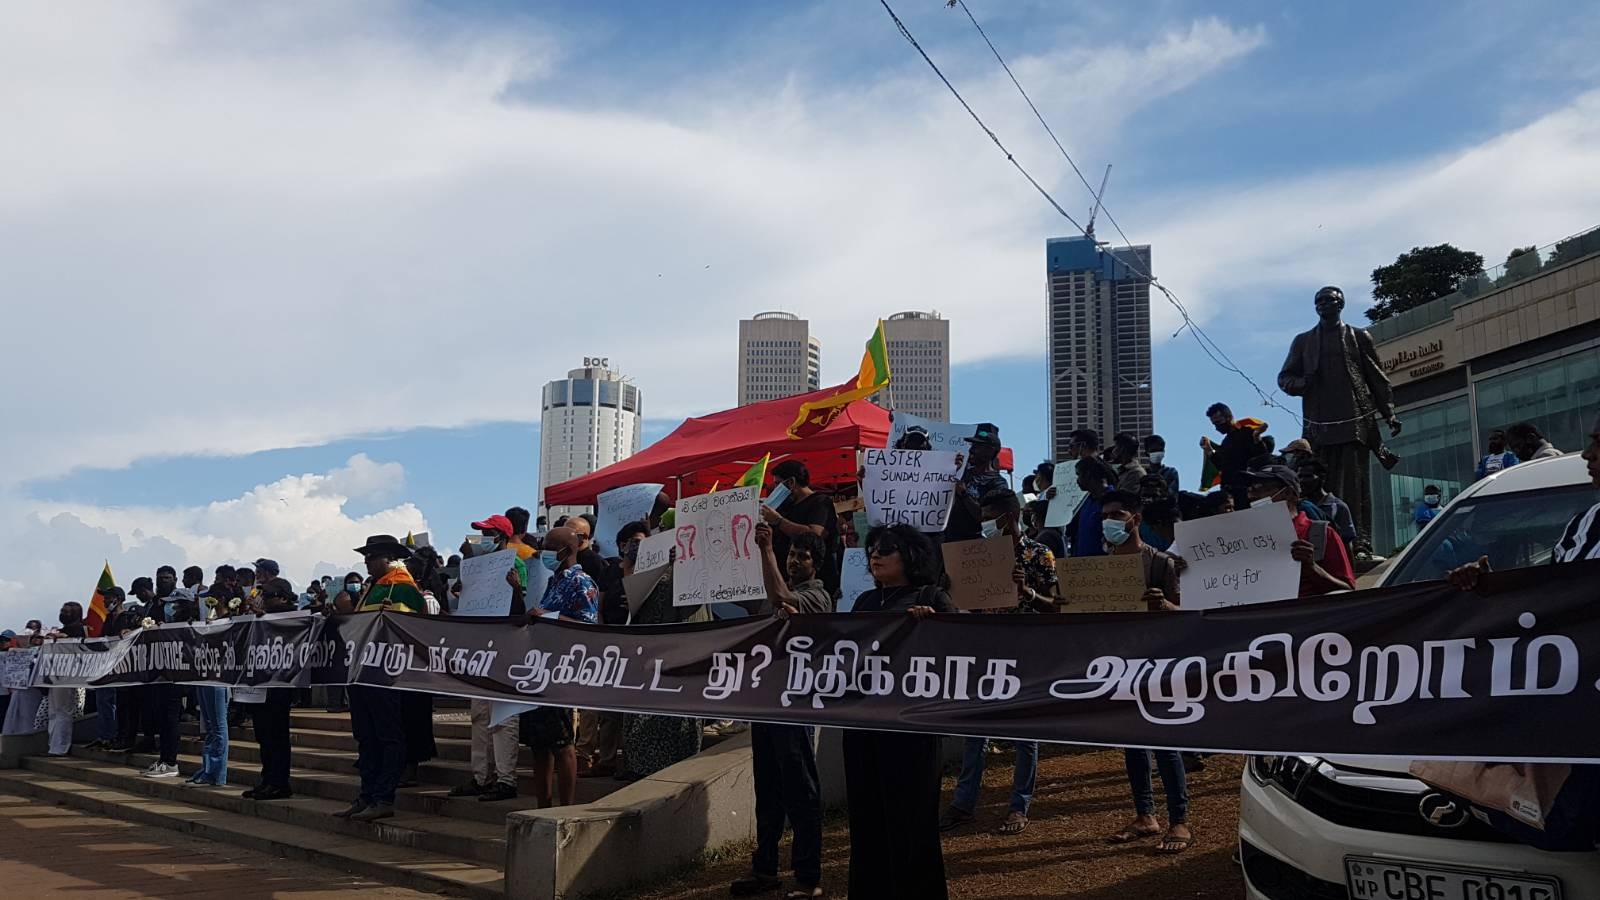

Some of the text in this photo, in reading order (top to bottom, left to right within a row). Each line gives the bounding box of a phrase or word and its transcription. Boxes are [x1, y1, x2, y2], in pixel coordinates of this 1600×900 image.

[583, 356, 609, 368] BOC
[866, 449, 923, 468] EASTER
[881, 469, 959, 483] SUNDAY ATTACKS
[872, 489, 953, 506] WE WANT
[881, 507, 946, 527] JUSTICE
[1190, 542, 1215, 561] It's
[1243, 568, 1262, 585] for
[344, 639, 356, 663] 3
[1354, 879, 1379, 897] WP
